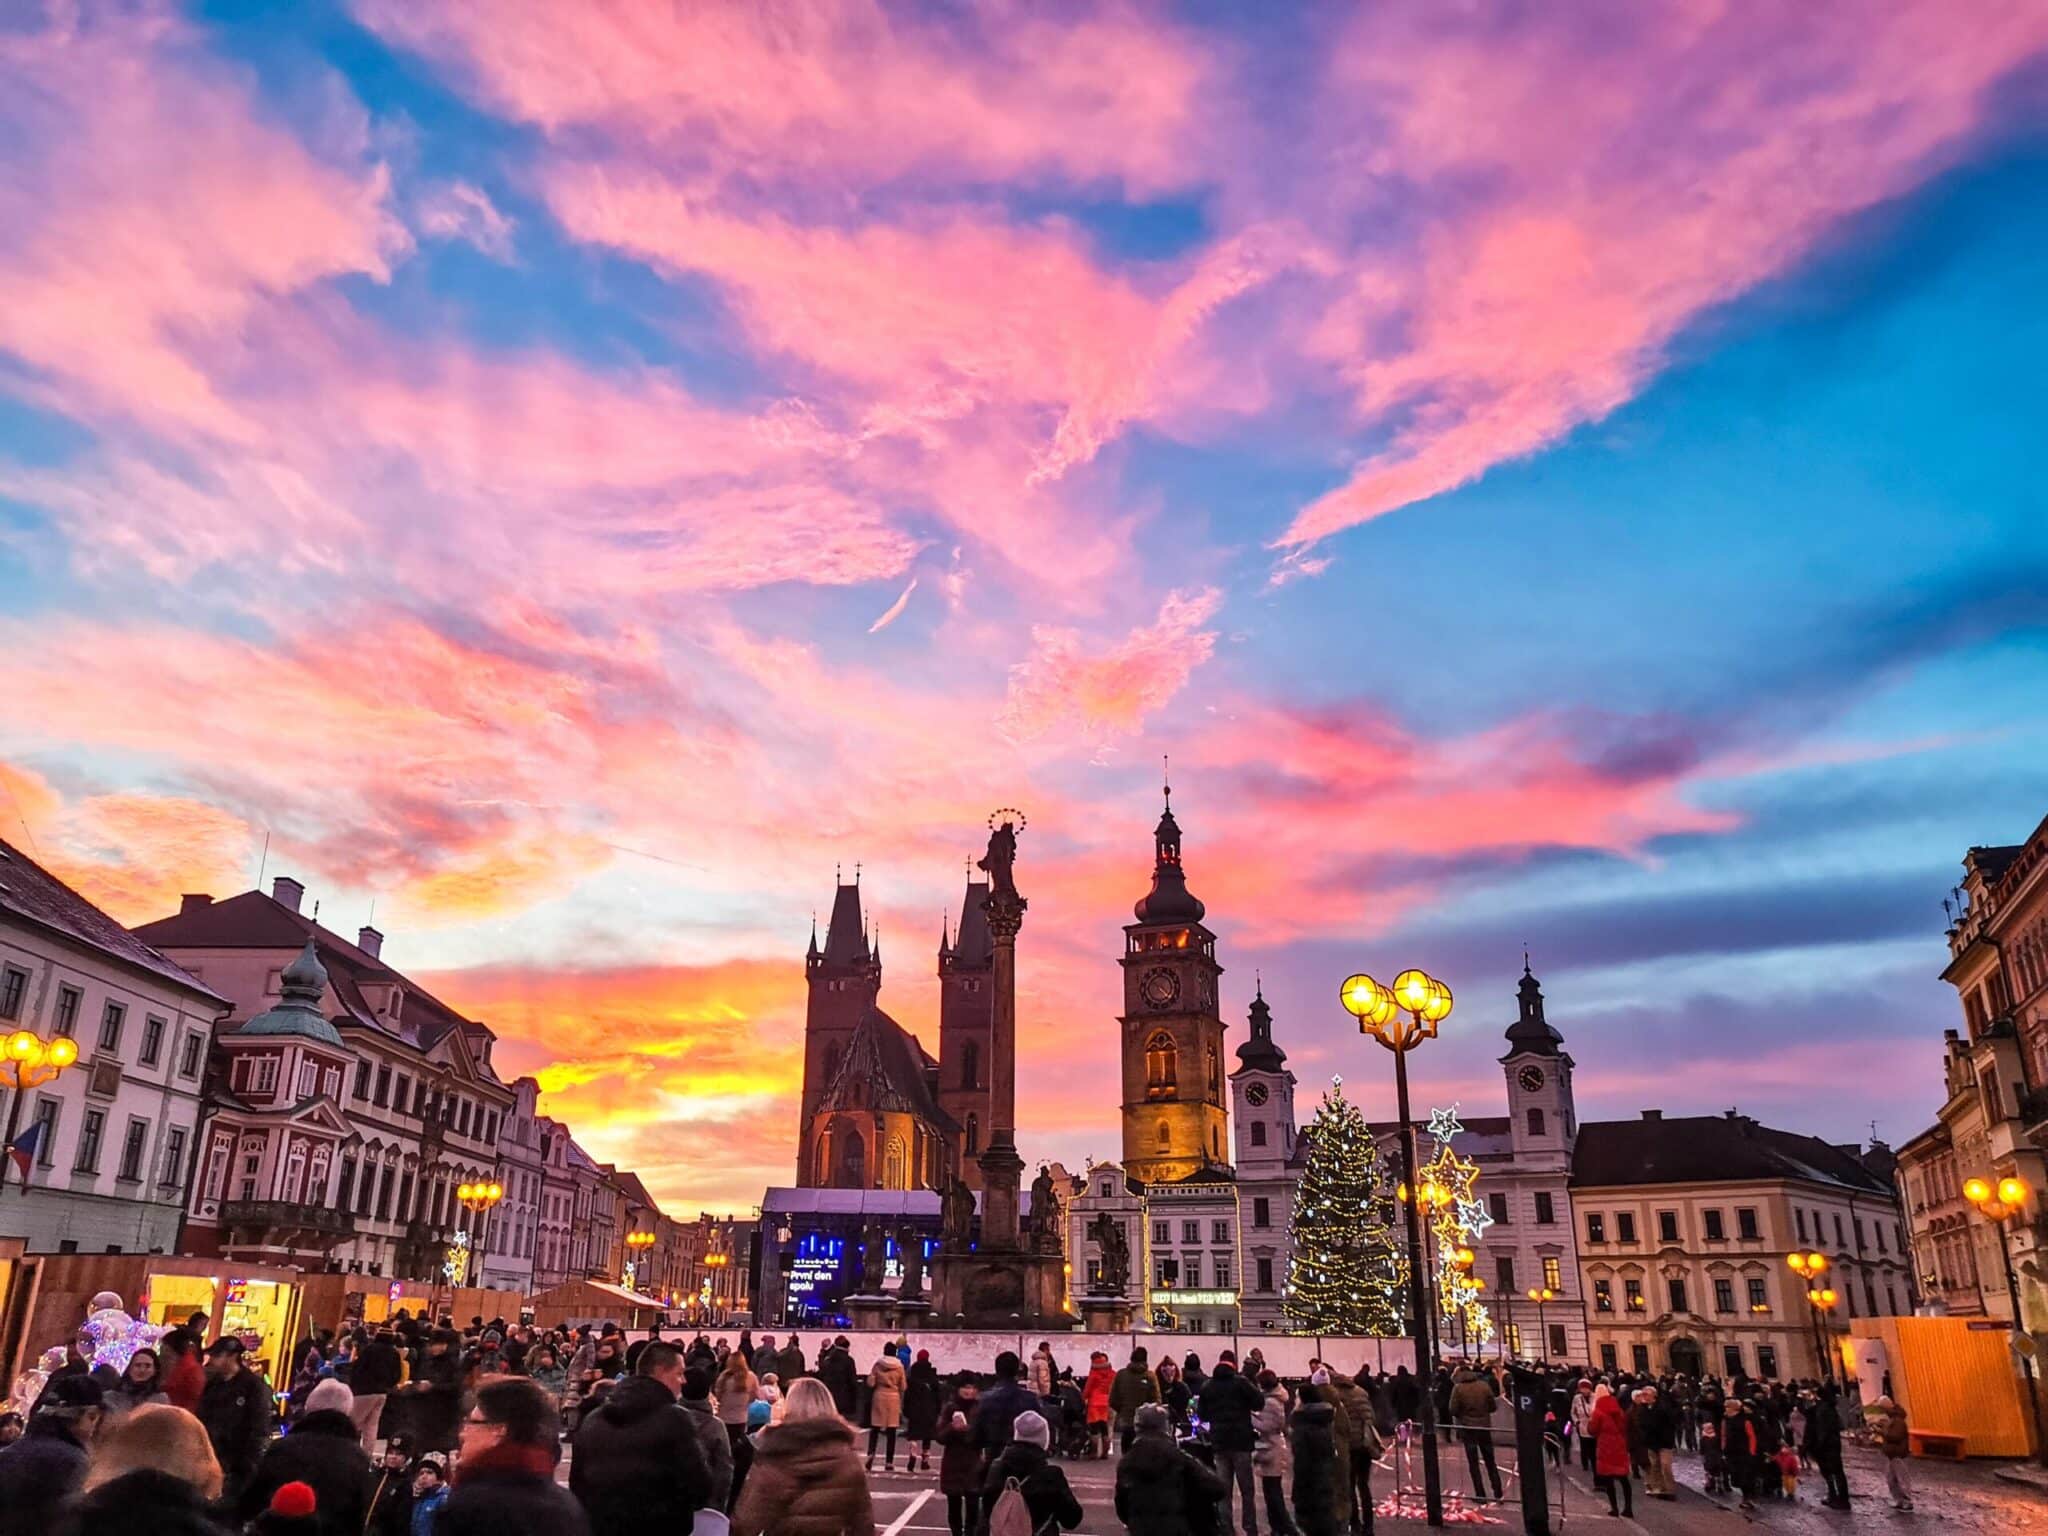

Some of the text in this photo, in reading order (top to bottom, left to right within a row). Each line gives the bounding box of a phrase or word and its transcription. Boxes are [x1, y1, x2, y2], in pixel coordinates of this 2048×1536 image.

[790, 1270, 832, 1281] První den
[1520, 1396, 1531, 1409] P
